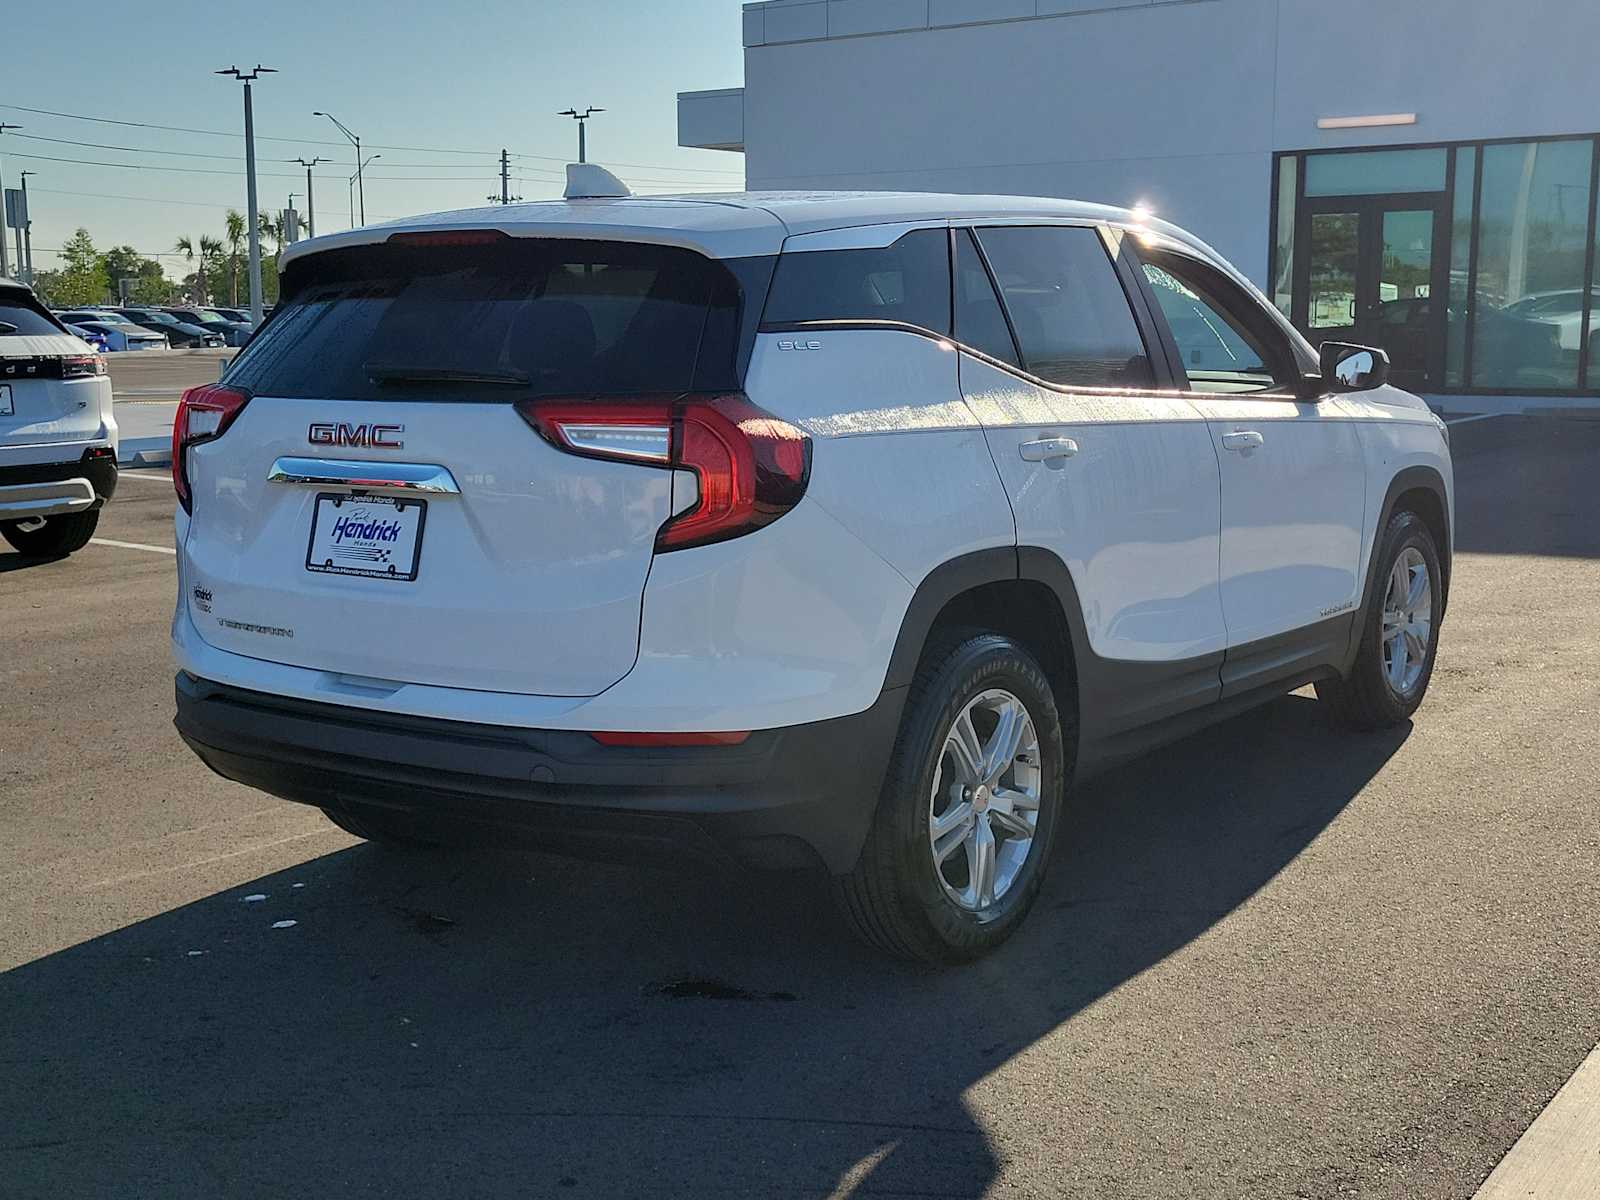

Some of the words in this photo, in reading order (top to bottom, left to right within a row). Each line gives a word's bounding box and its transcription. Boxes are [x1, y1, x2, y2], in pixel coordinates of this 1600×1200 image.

[777, 340, 822, 351] SLE
[308, 422, 405, 448] GMC
[331, 516, 402, 544] Hendrick
